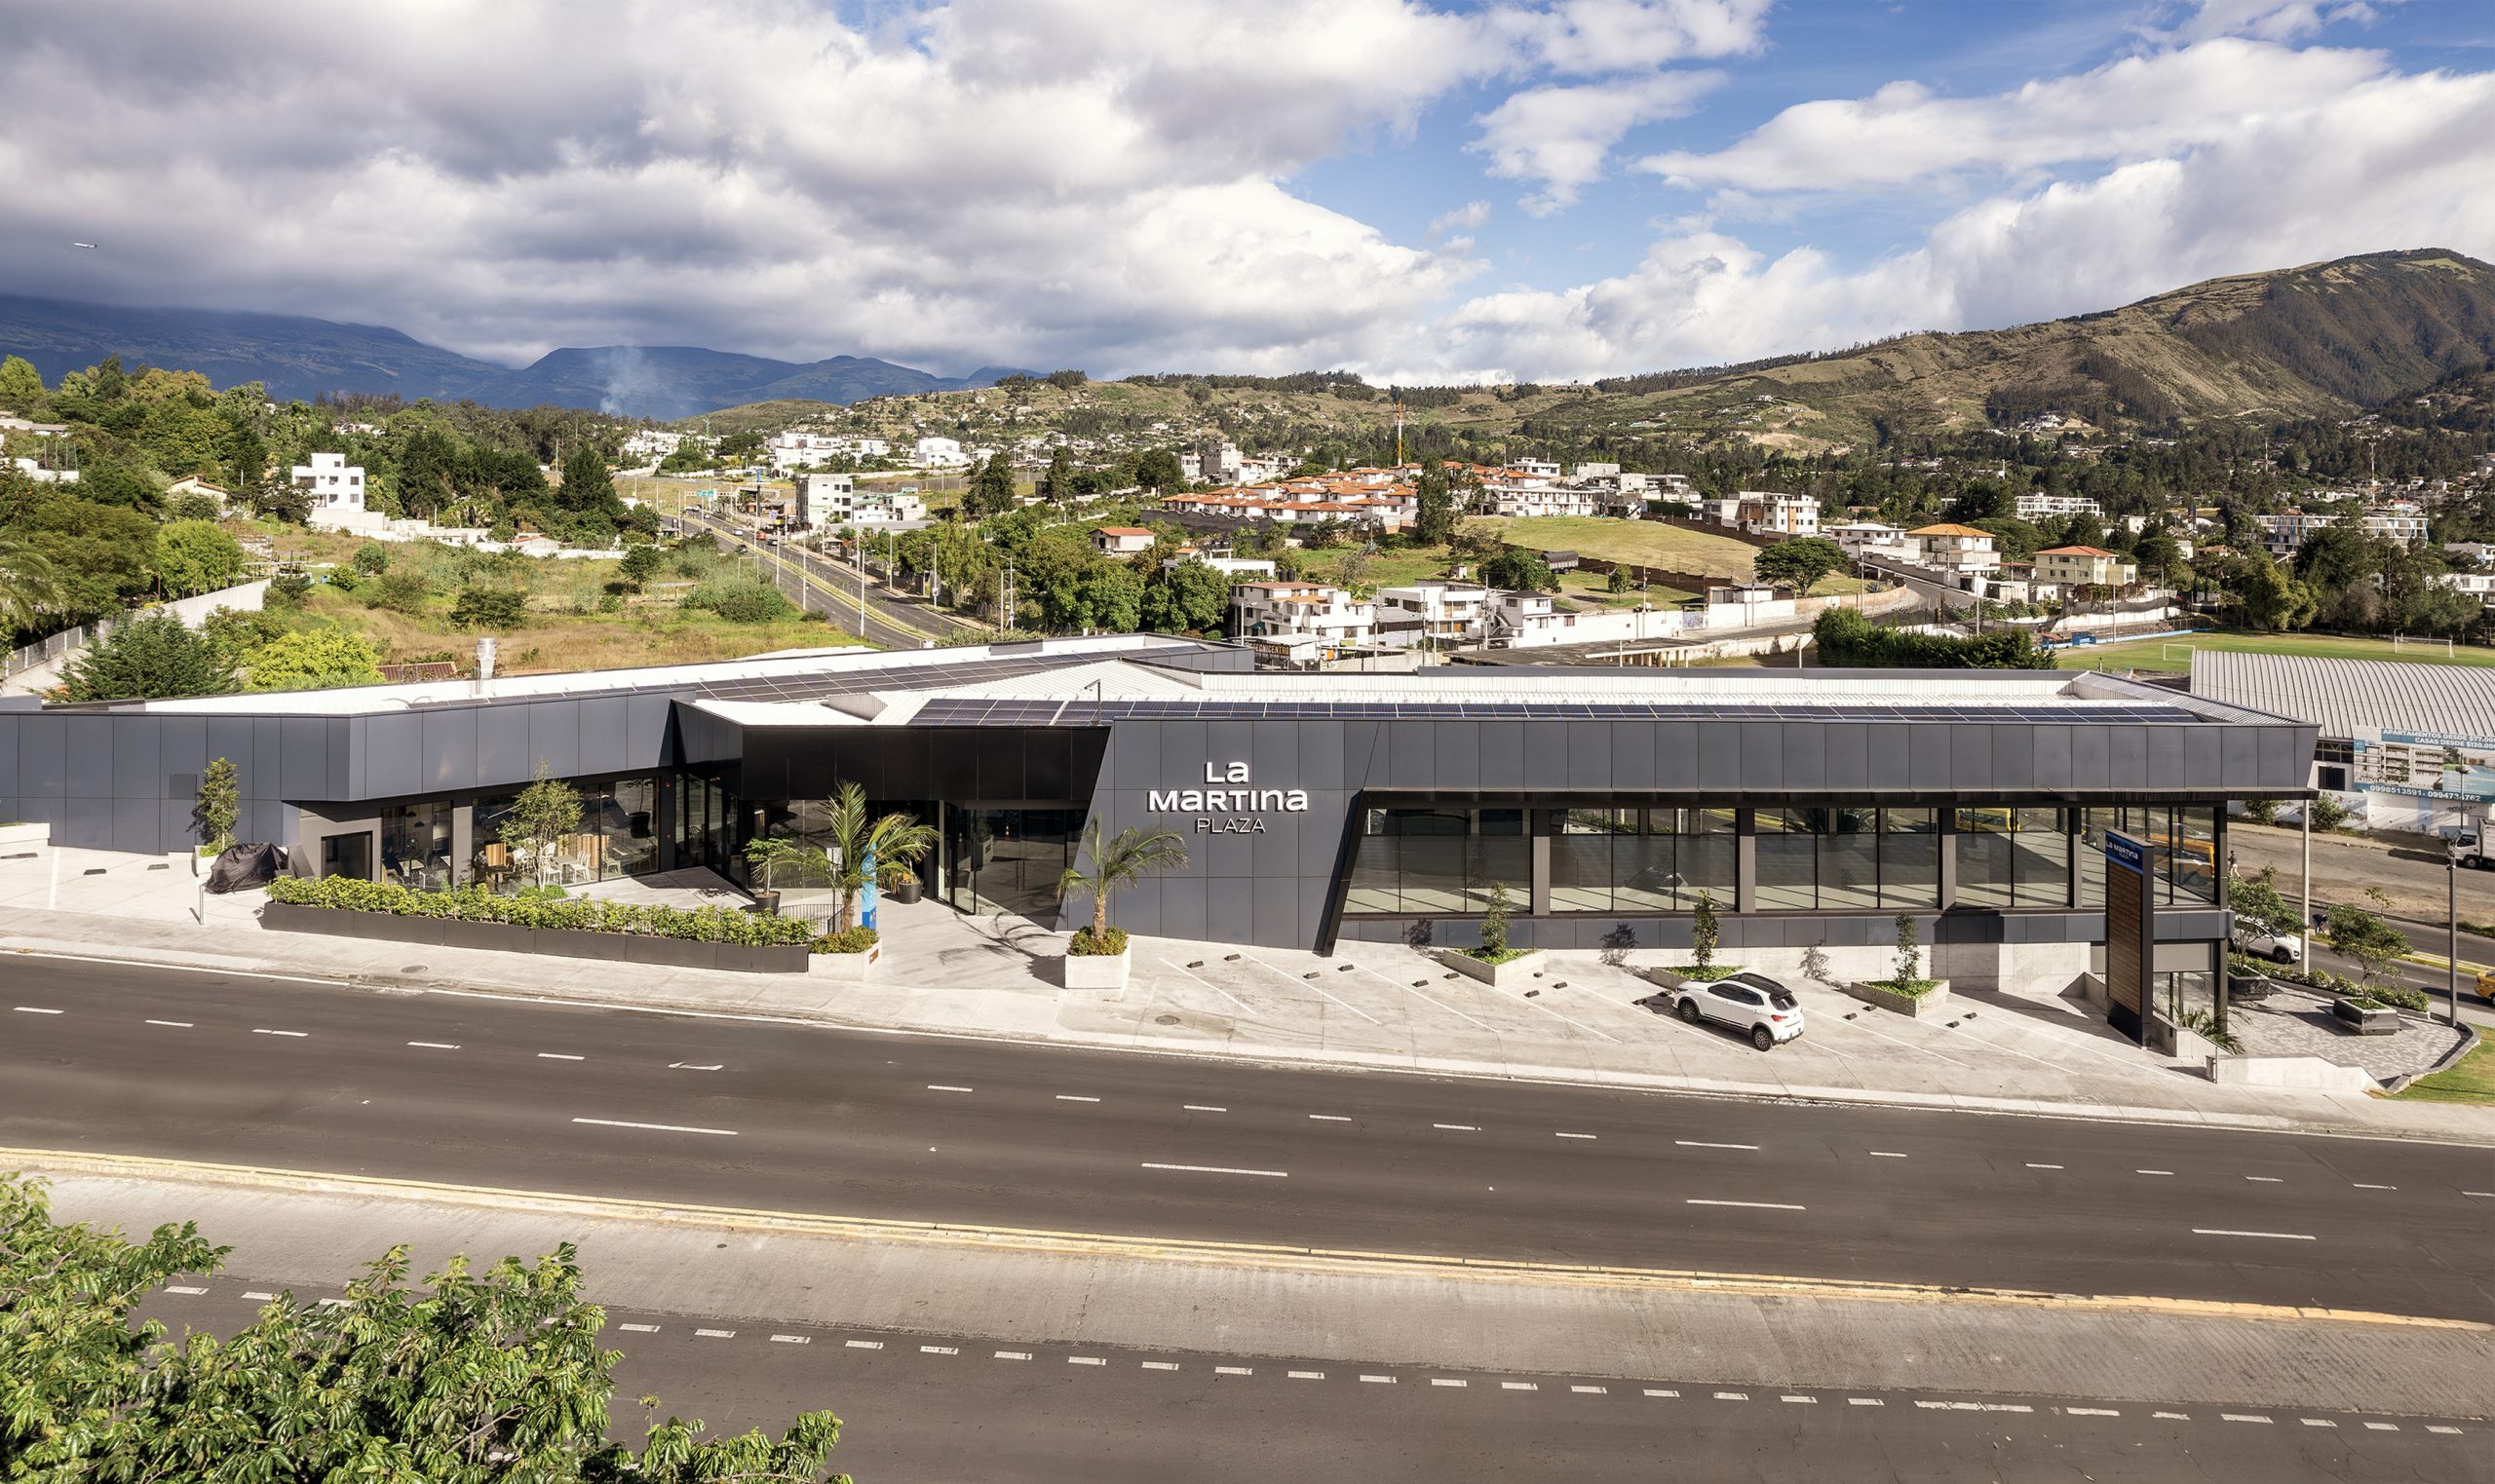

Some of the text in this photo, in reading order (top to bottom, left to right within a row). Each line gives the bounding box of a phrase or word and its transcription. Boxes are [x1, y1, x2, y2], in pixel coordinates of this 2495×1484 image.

[2383, 728, 2441, 739] APARTAMENTOS
[1205, 761, 1249, 783] La
[1196, 818, 1266, 833] PLAZA
